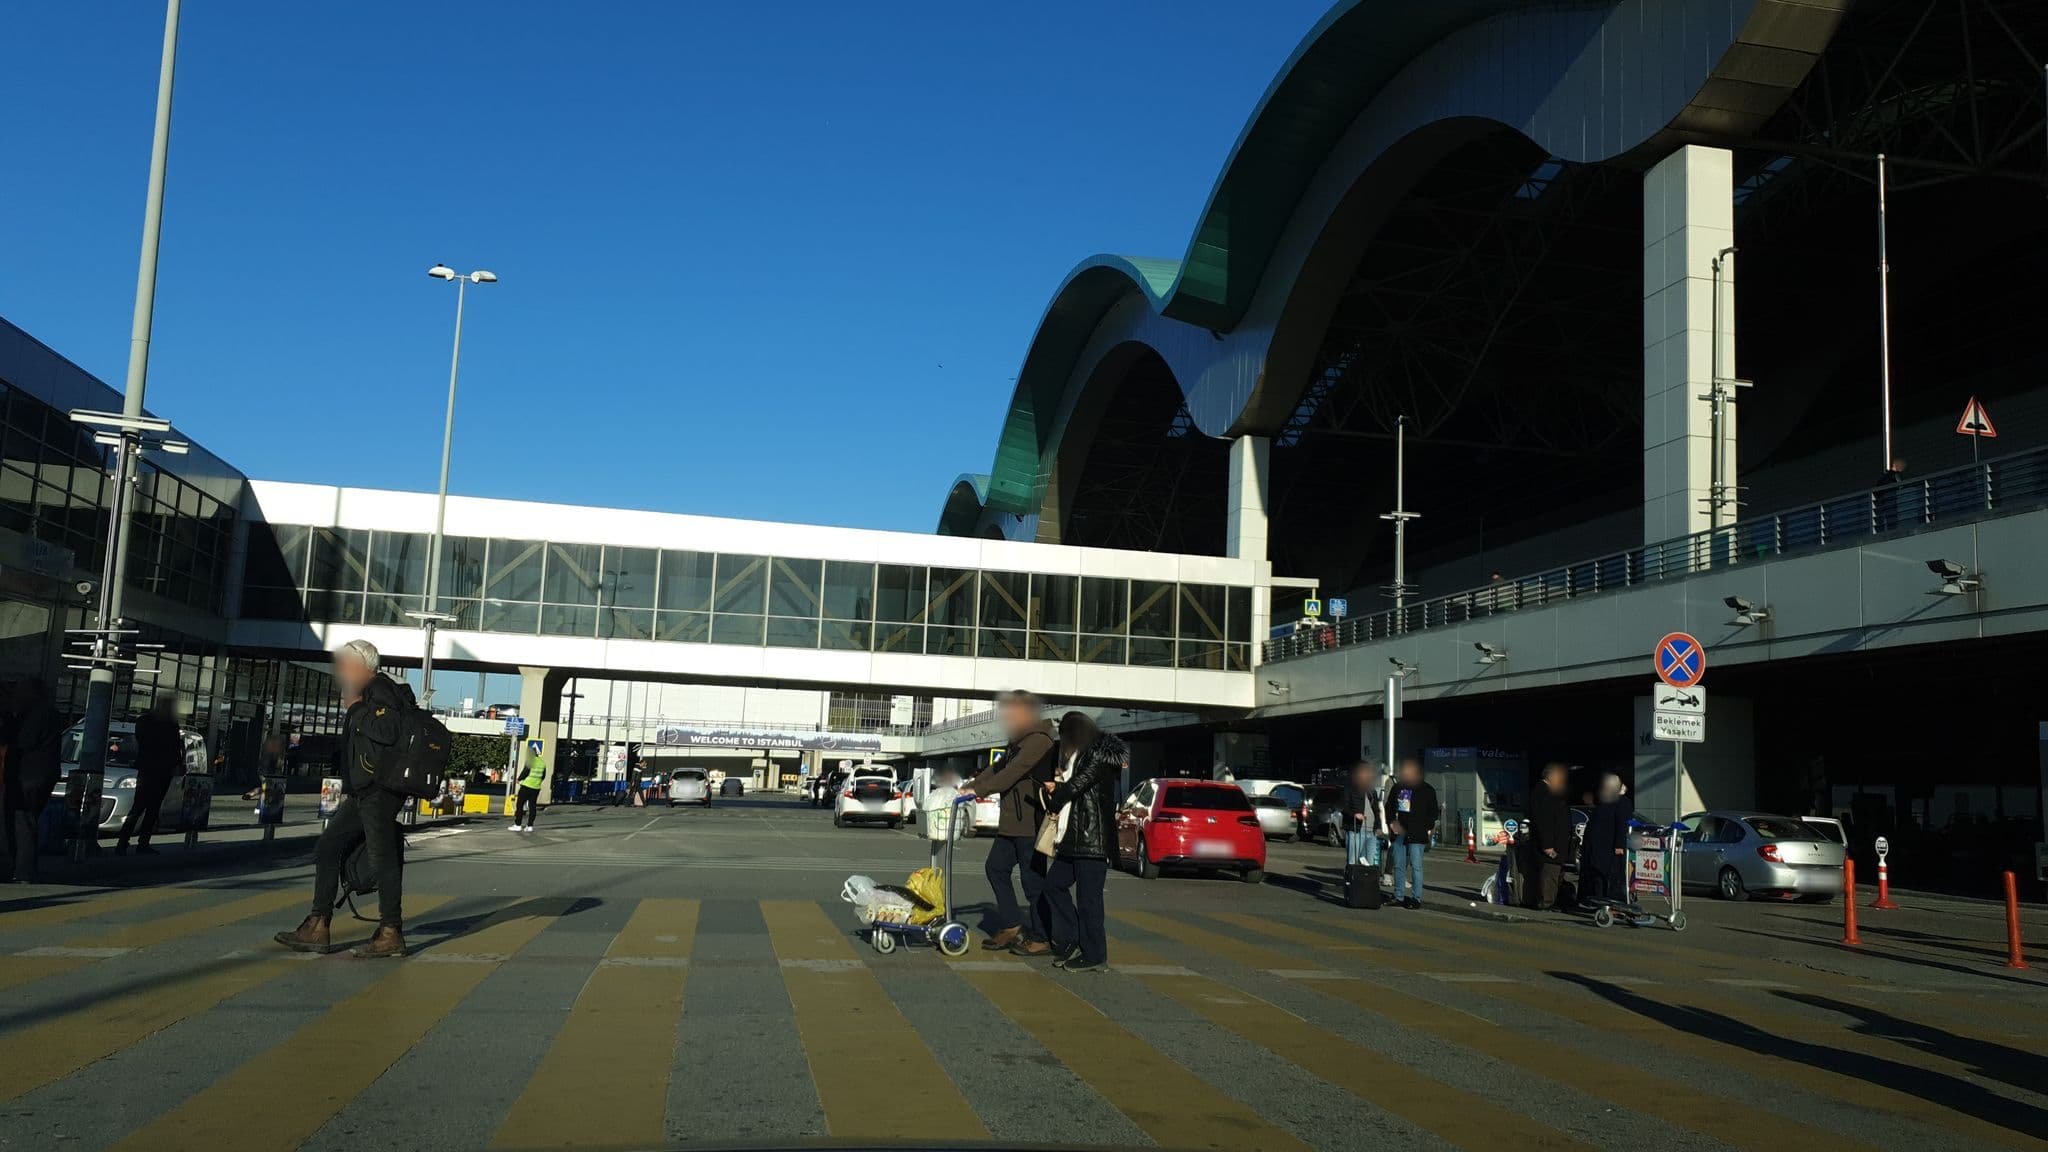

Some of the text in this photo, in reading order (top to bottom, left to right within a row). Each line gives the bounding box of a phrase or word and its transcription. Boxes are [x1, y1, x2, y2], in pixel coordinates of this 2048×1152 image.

[1657, 716, 1702, 727] Beklemek
[1660, 727, 1697, 737] Yasaktır
[690, 735, 804, 748] WELCOME TO ISTANBUL
[1481, 748, 1506, 758] vale
[1643, 859, 1658, 871] 40
